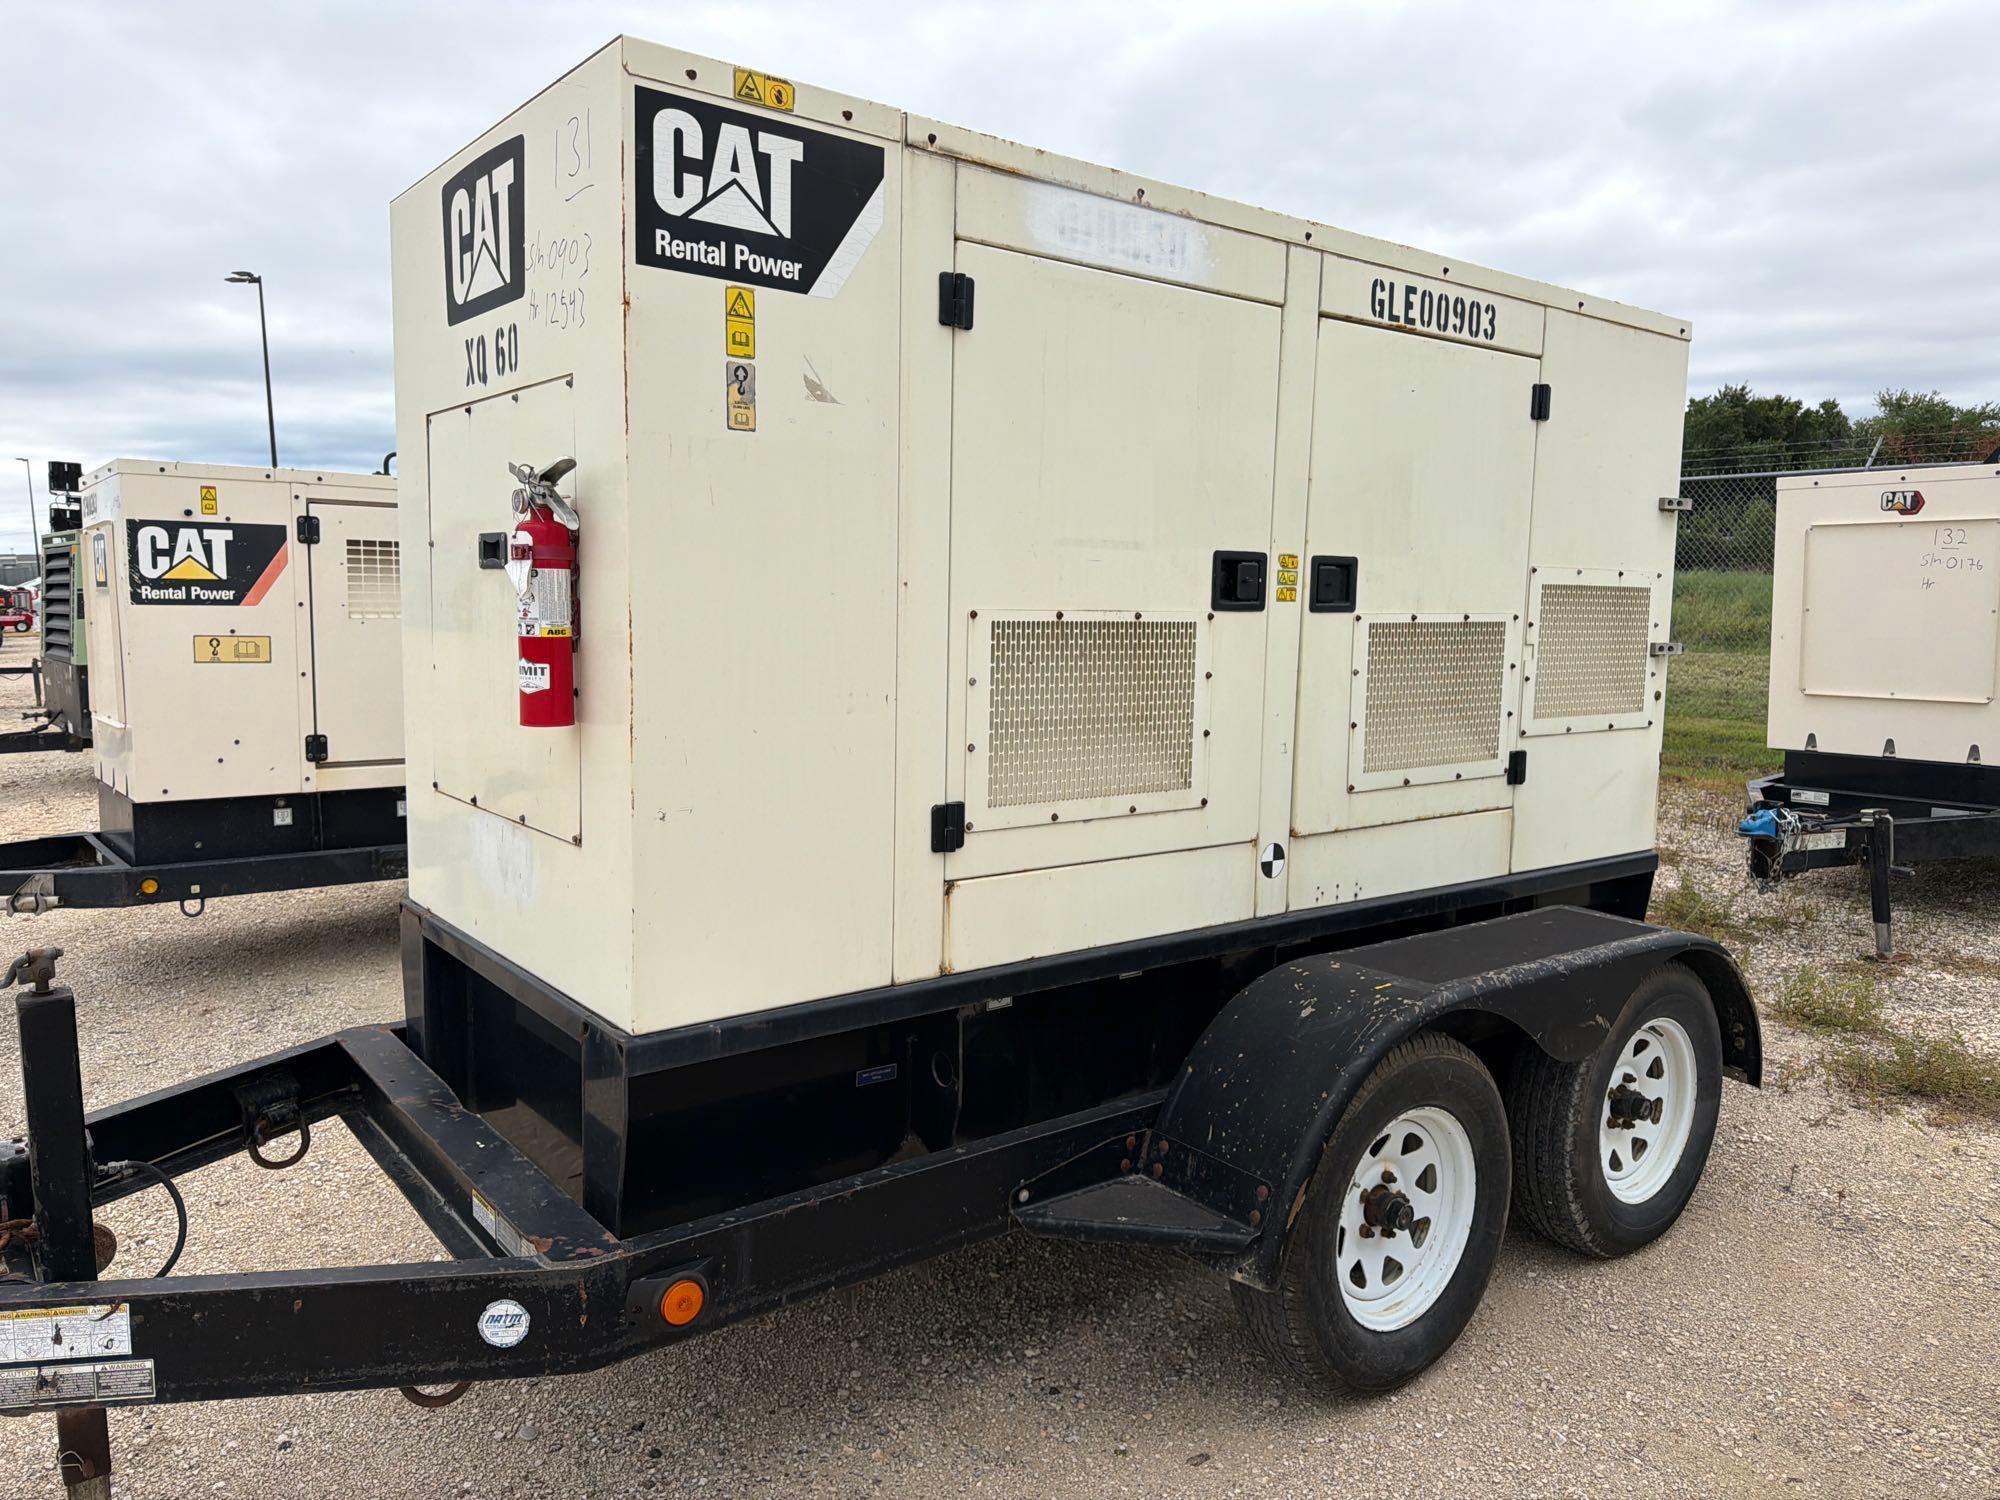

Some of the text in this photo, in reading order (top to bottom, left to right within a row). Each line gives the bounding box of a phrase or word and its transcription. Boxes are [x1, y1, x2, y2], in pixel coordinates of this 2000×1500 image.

[555, 107, 591, 188] 131
[653, 108, 804, 239] CAT
[450, 157, 516, 305] CAT
[655, 228, 803, 282] Rental Power
[1371, 278, 1497, 341] GLE00903
[495, 322, 519, 377] 60
[1882, 492, 1915, 511] CAT
[137, 525, 234, 580] CAT
[1934, 528, 1968, 546] 132
[141, 585, 236, 601] Rental Power
[109, 1362, 146, 1370] WARNING
